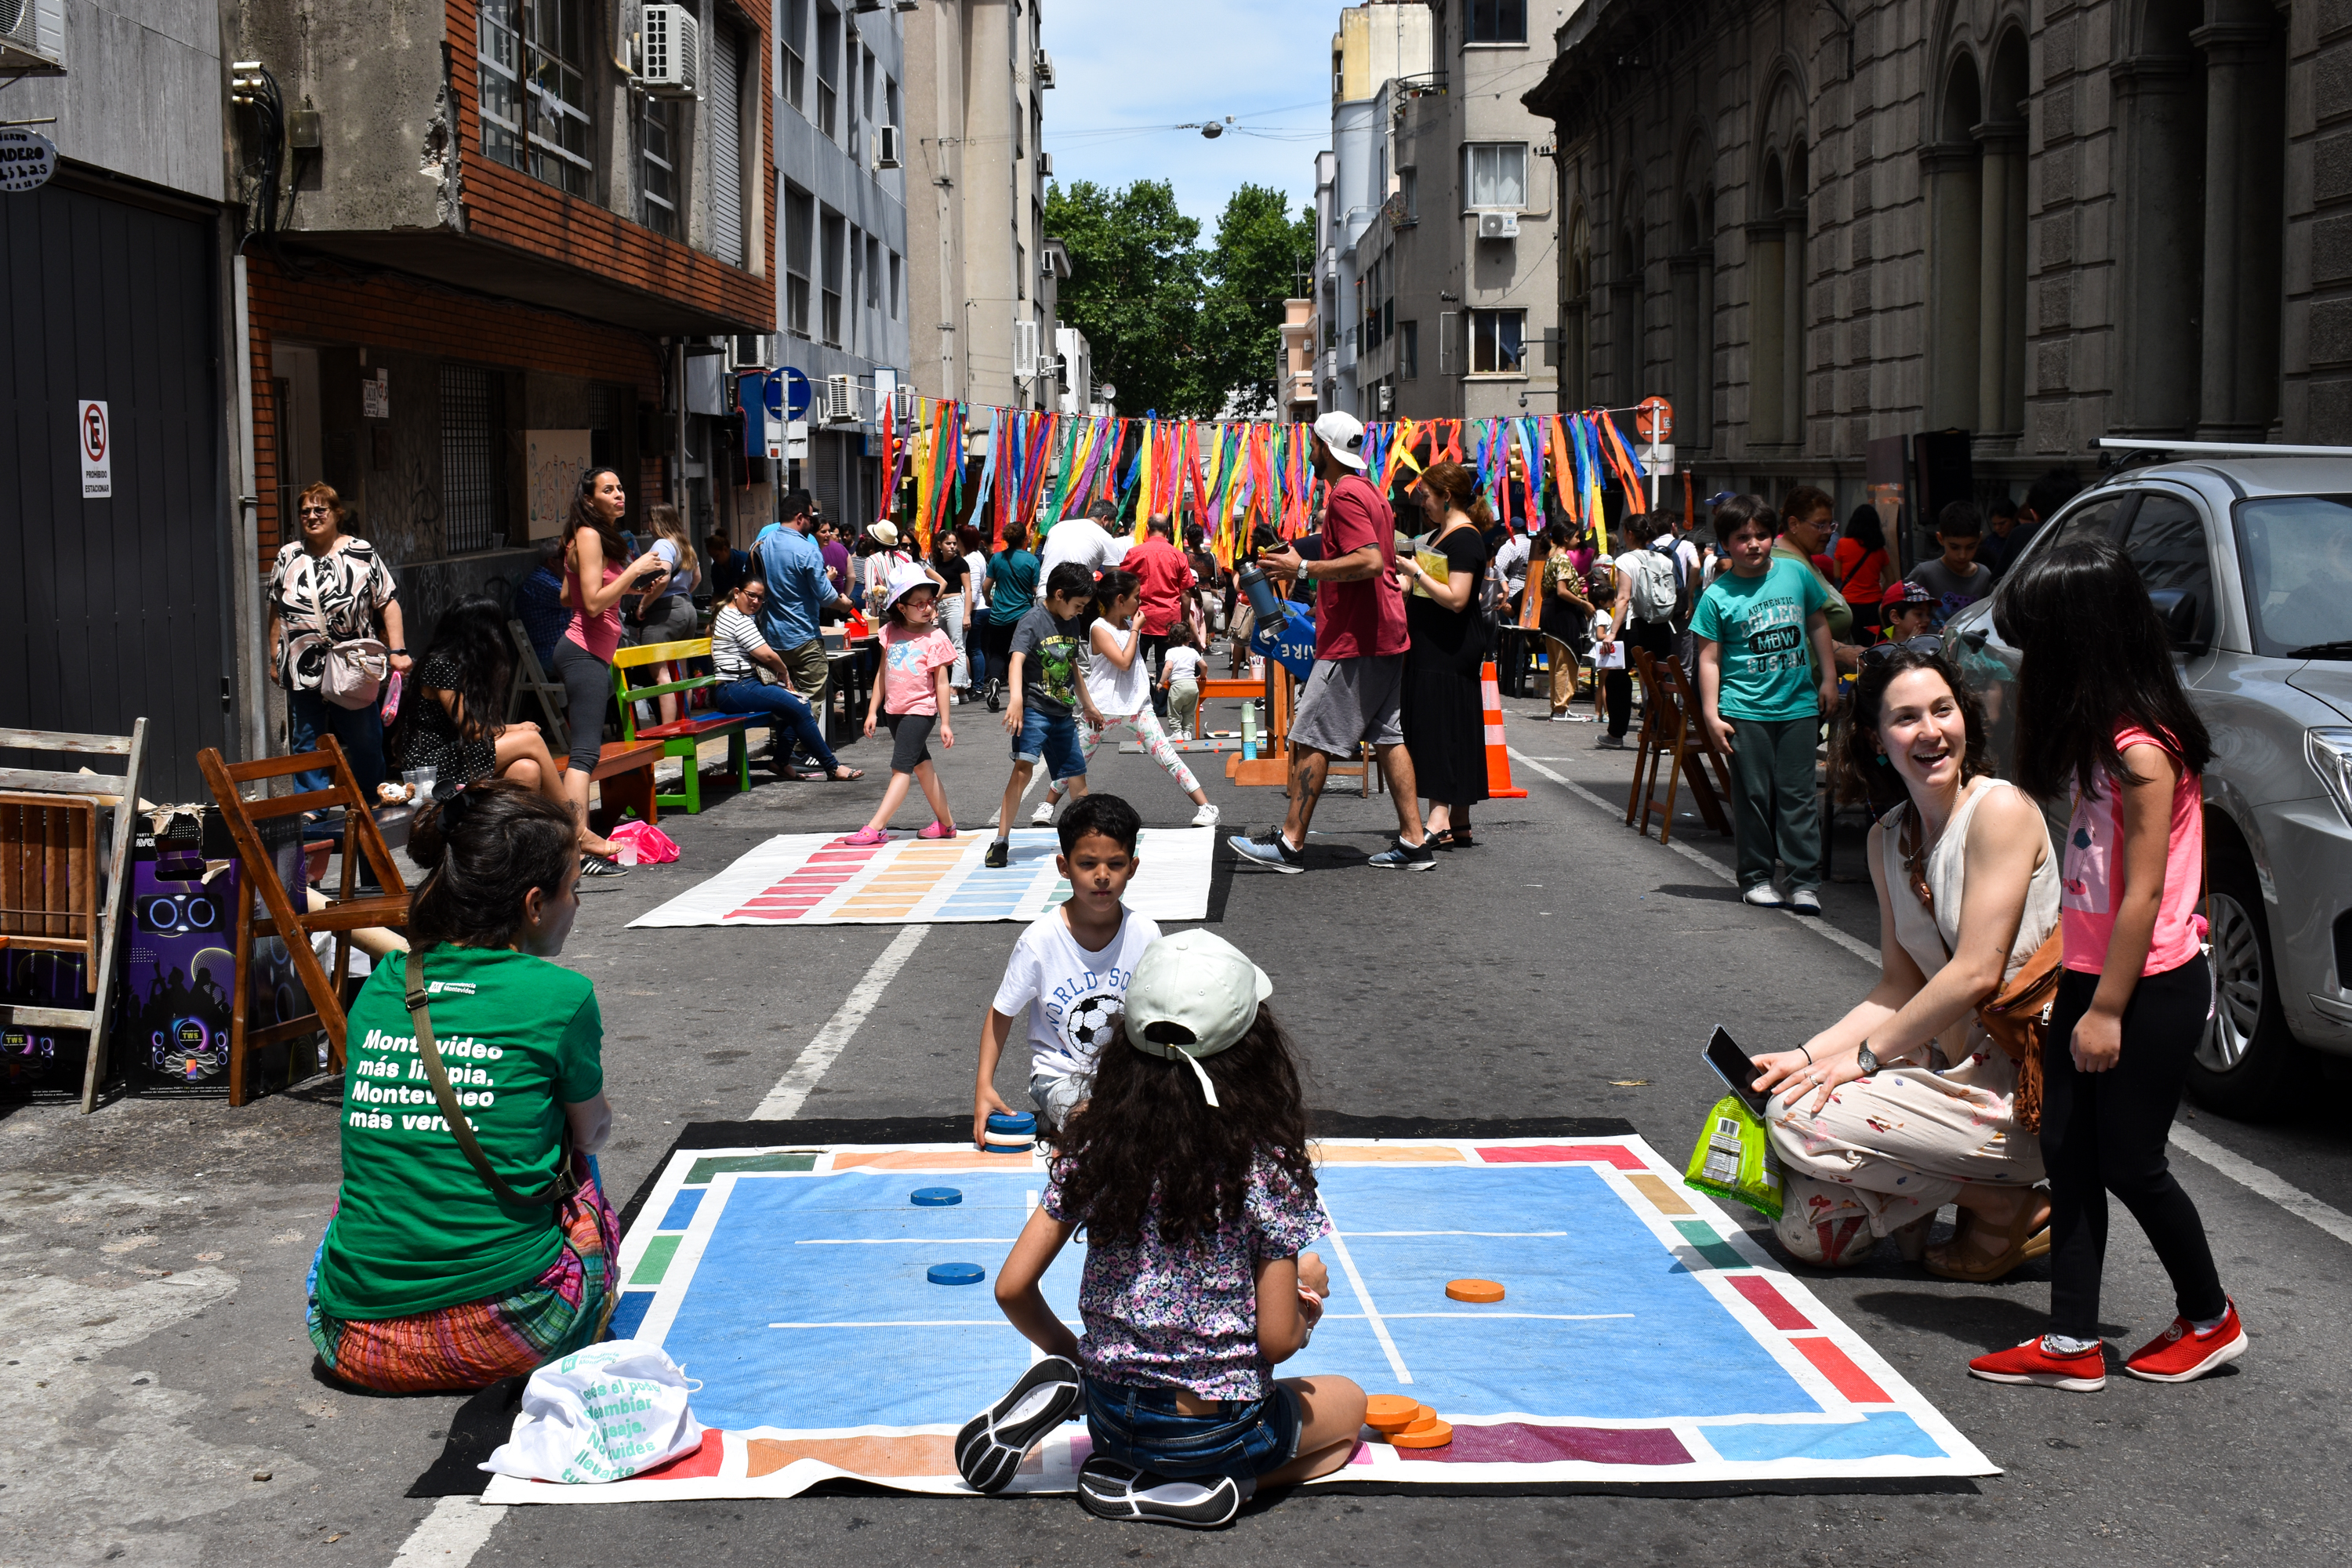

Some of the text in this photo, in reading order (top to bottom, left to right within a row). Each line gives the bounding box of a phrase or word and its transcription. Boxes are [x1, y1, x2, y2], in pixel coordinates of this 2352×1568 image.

[85, 470, 107, 479] PROHIBIDO
[85, 485, 109, 493] ESTACIONAR
[1748, 597, 1794, 616] AUTHENTIC
[1746, 649, 1806, 673] CUSTOM
[443, 985, 475, 995] Montevideo
[1109, 967, 1131, 993] SQ
[362, 1029, 503, 1060] Montvideo
[356, 1055, 494, 1087] más lipia,
[350, 1108, 393, 1129] más
[612, 1378, 626, 1394] el
[574, 1448, 635, 1480] llevarte
